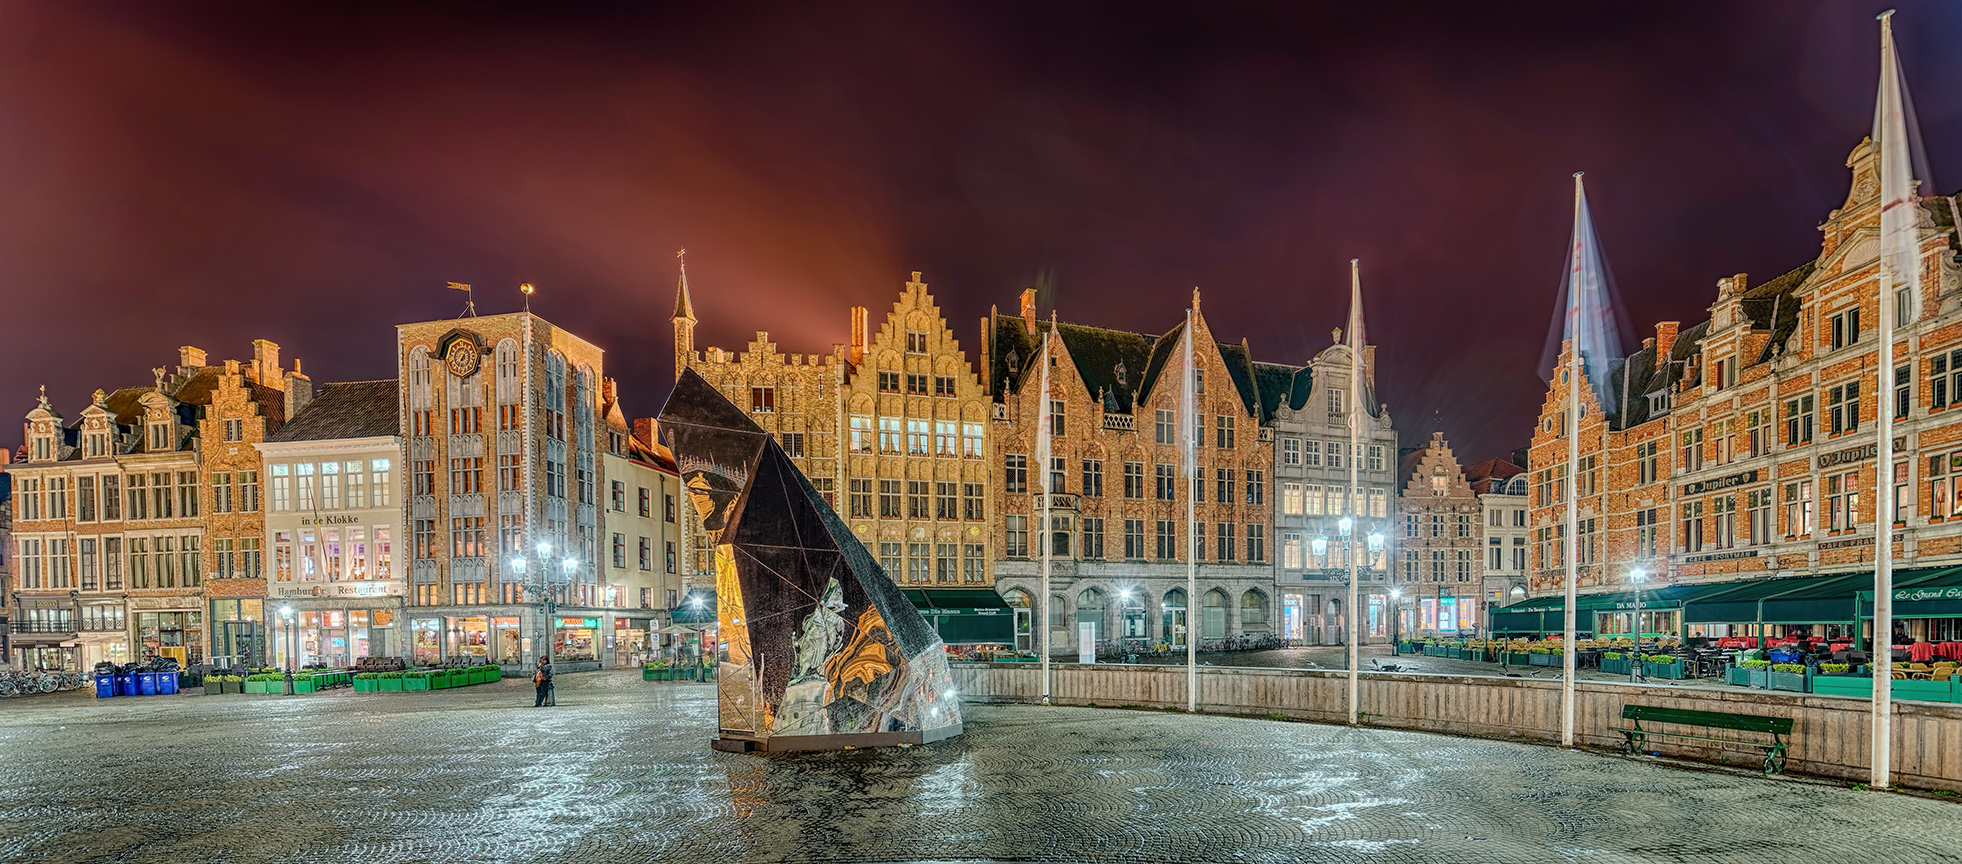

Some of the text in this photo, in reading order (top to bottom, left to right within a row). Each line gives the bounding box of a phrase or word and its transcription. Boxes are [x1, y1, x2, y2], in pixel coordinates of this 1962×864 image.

[1834, 445, 1878, 462] Jupile
[1700, 477, 1738, 492] Jupiler
[302, 516, 310, 525] in
[326, 515, 358, 525] Klokke
[1820, 534, 1901, 549] CAFE FRANS
[1711, 551, 1751, 561] SPORTMAN
[337, 585, 387, 595] Restaurant
[1895, 590, 1910, 599] Le
[1911, 589, 1943, 601] Grand
[1626, 601, 1647, 609] MAIO
